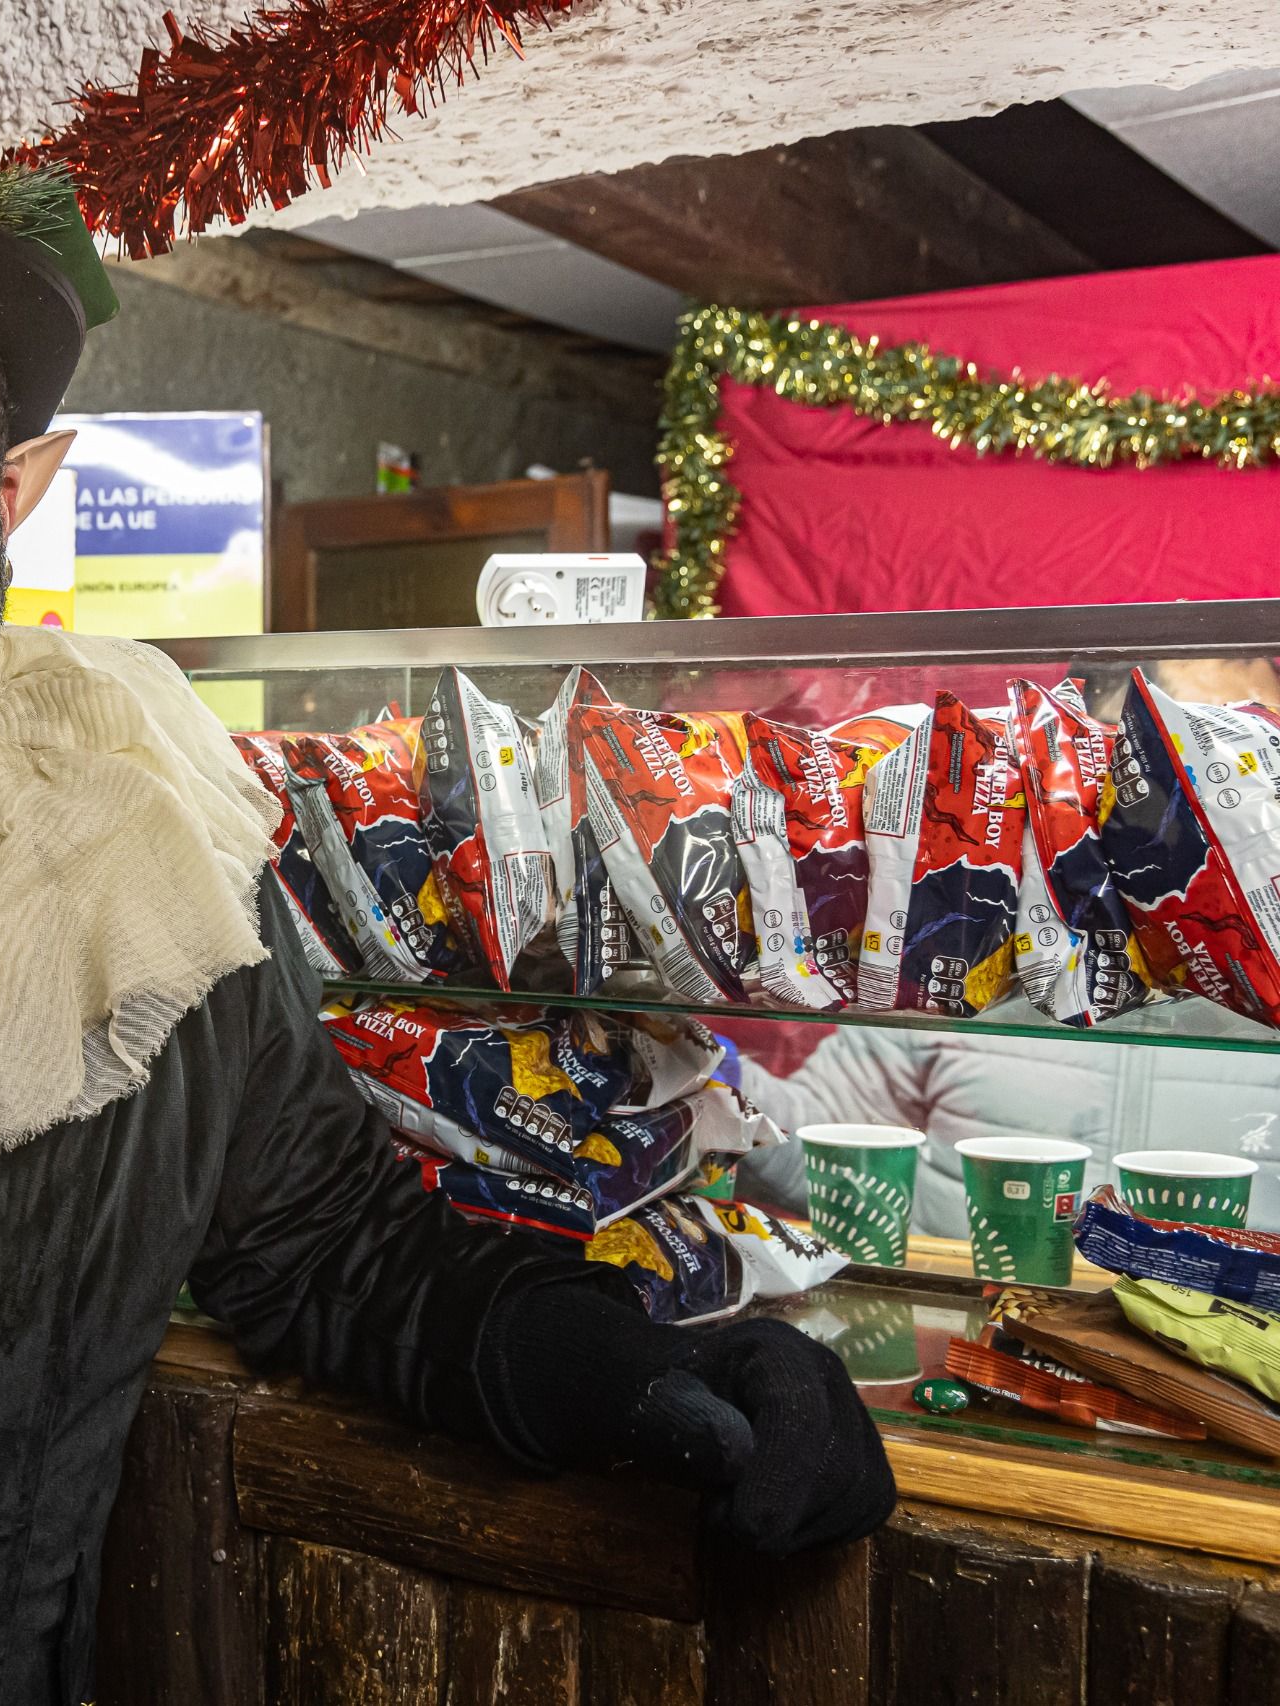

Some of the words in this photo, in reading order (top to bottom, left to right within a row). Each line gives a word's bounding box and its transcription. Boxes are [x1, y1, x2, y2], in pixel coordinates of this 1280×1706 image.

[78, 489, 97, 507] A
[98, 488, 138, 507] LAS
[96, 511, 124, 531] LA
[128, 510, 157, 531] UE
[635, 736, 668, 782] PIZZA
[636, 710, 677, 766] SURFER
[669, 765, 696, 798] BOY
[1074, 737, 1096, 787] PIZZA
[1087, 721, 1108, 777] RFER
[256, 756, 287, 792] PIZZA
[322, 754, 349, 791] PIZZA
[800, 756, 824, 805] PIZZA
[808, 730, 839, 791] SURFER
[826, 794, 849, 829] BOY
[972, 763, 991, 815] PIZZA
[993, 735, 1009, 807] SURFER
[352, 778, 377, 807] BOY
[985, 812, 1002, 849] BOY
[1163, 920, 1187, 956] BOY
[1193, 940, 1230, 993] PIZZA
[356, 1014, 394, 1041] PIZZA
[395, 1018, 426, 1039] BOY
